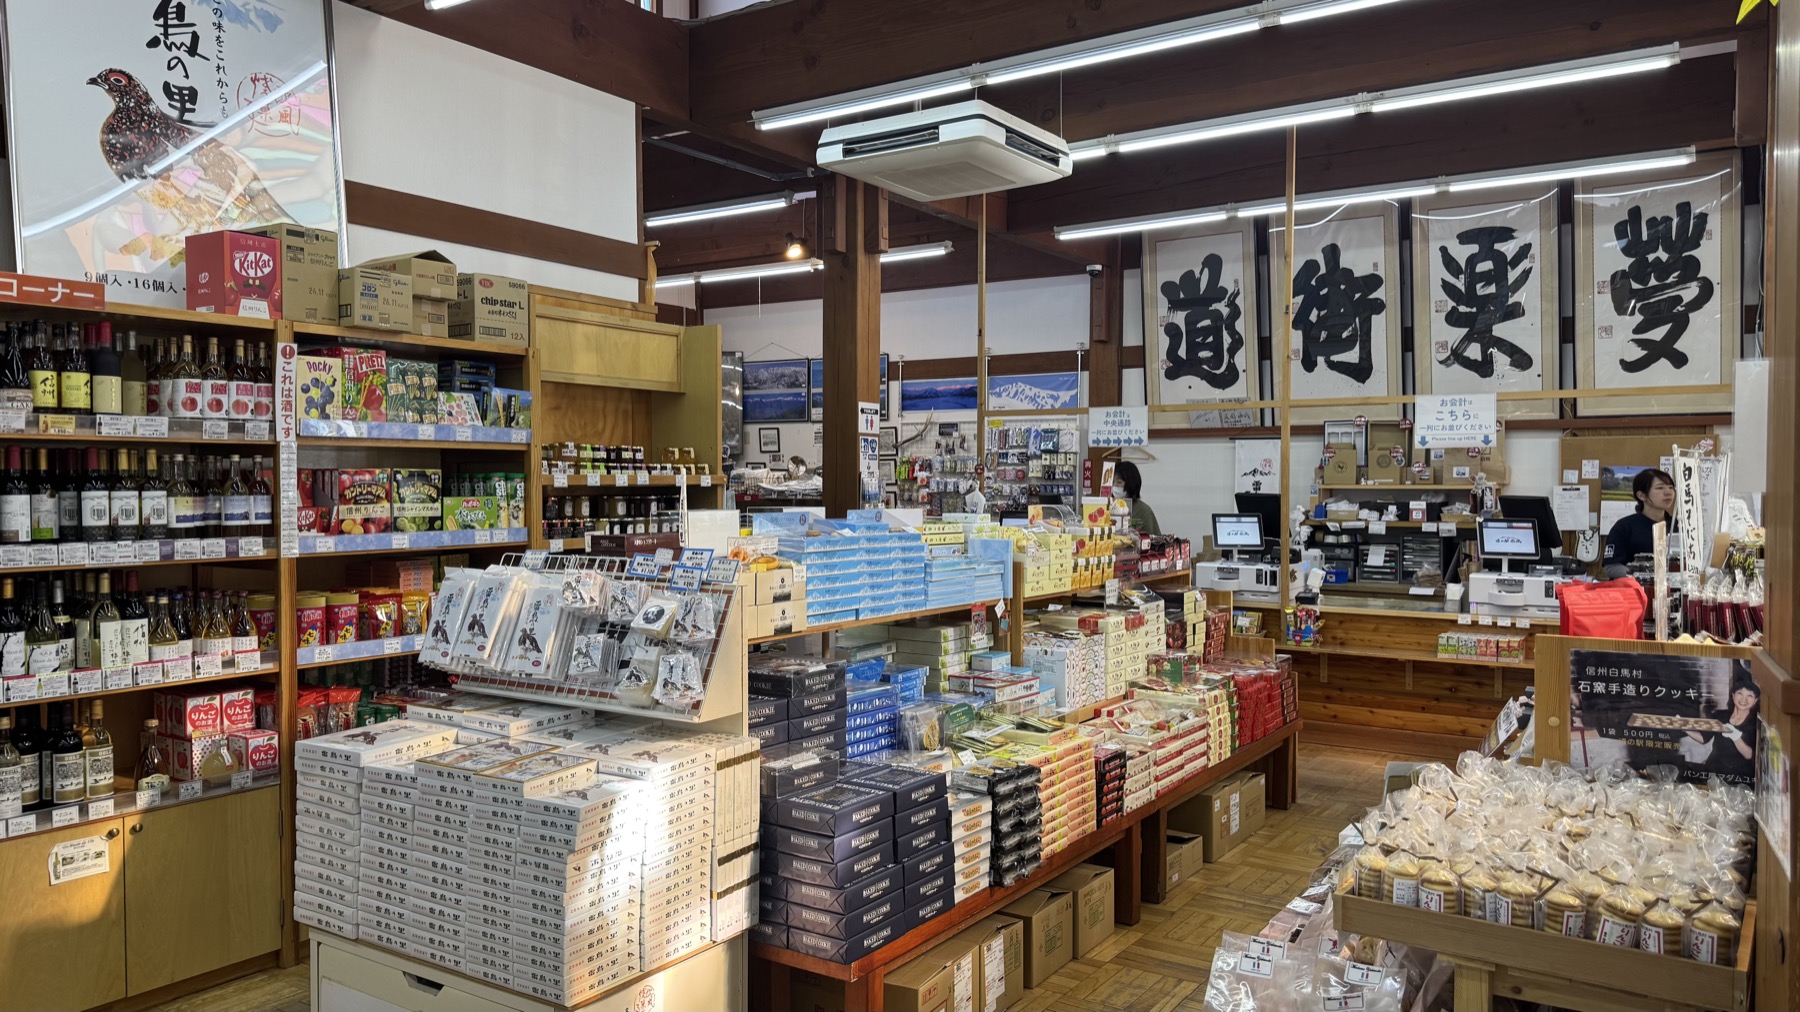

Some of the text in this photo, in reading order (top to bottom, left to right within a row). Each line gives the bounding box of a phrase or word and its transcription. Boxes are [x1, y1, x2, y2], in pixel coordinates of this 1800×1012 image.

[211, 0, 229, 119] の味をこれからも
[239, 253, 272, 276] KitKat
[0, 278, 95, 303] コーナー
[281, 361, 294, 439] これは酒です
[1440, 397, 1472, 407] お会計は
[1435, 409, 1479, 421] こちらに
[1103, 419, 1132, 427] 中央通路
[1419, 423, 1492, 432] 一列にお並びください
[1084, 460, 1092, 487] 消火器
[344, 485, 387, 499] カントリーマアム
[346, 505, 385, 515] 信州りんご
[1585, 665, 1642, 679] 信州白馬村
[1578, 680, 1714, 699] 石窯手造りクッキー
[191, 710, 216, 720] りんご
[227, 705, 251, 715] りんご
[1623, 729, 1653, 739] 500円
[253, 750, 275, 760] りんご
